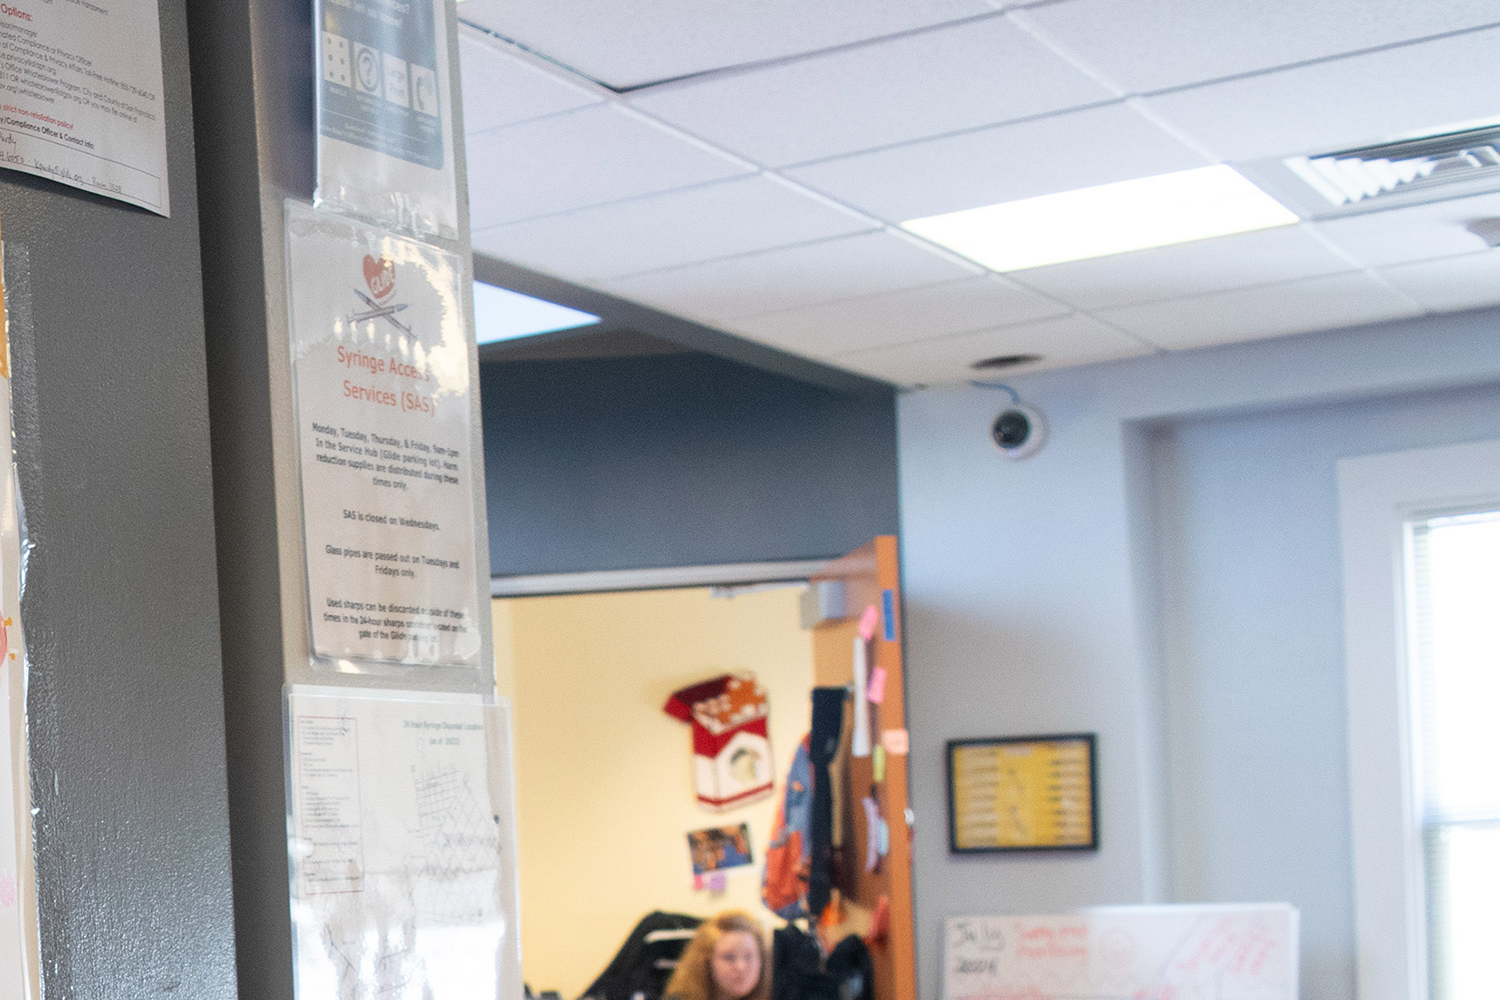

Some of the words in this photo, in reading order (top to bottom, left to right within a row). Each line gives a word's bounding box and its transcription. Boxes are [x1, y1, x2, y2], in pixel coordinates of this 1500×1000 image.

[0, 3, 33, 22] Options:
[337, 345, 385, 374] Syringe
[343, 380, 397, 407] Services
[400, 390, 435, 418] (SAS)
[312, 422, 339, 438] Monday,
[340, 427, 370, 443] Tuesday,
[371, 433, 402, 448] Thursday,
[404, 438, 410, 449] &
[410, 440, 430, 454] Friday,
[316, 438, 323, 448] In
[324, 440, 336, 450] the
[338, 442, 362, 455] Service
[364, 446, 378, 458] Hub
[380, 448, 400, 462] (Glide
[402, 453, 427, 468] parking
[316, 452, 346, 466] reduction
[348, 458, 374, 472] supplies
[375, 463, 386, 473] are
[388, 464, 422, 478] distributed
[424, 470, 443, 484] during
[372, 476, 391, 488] times
[392, 478, 409, 491] only.
[342, 508, 356, 520] SAS
[358, 511, 364, 522] is
[365, 512, 387, 524] closed
[325, 544, 342, 556] Glass
[344, 548, 361, 558] pipes
[362, 550, 373, 560] are
[374, 552, 398, 562] passed
[400, 554, 411, 563] out
[412, 556, 420, 564] on
[375, 564, 400, 578] Fridays
[326, 597, 342, 608] Used
[365, 602, 376, 612] can
[378, 602, 387, 612] be
